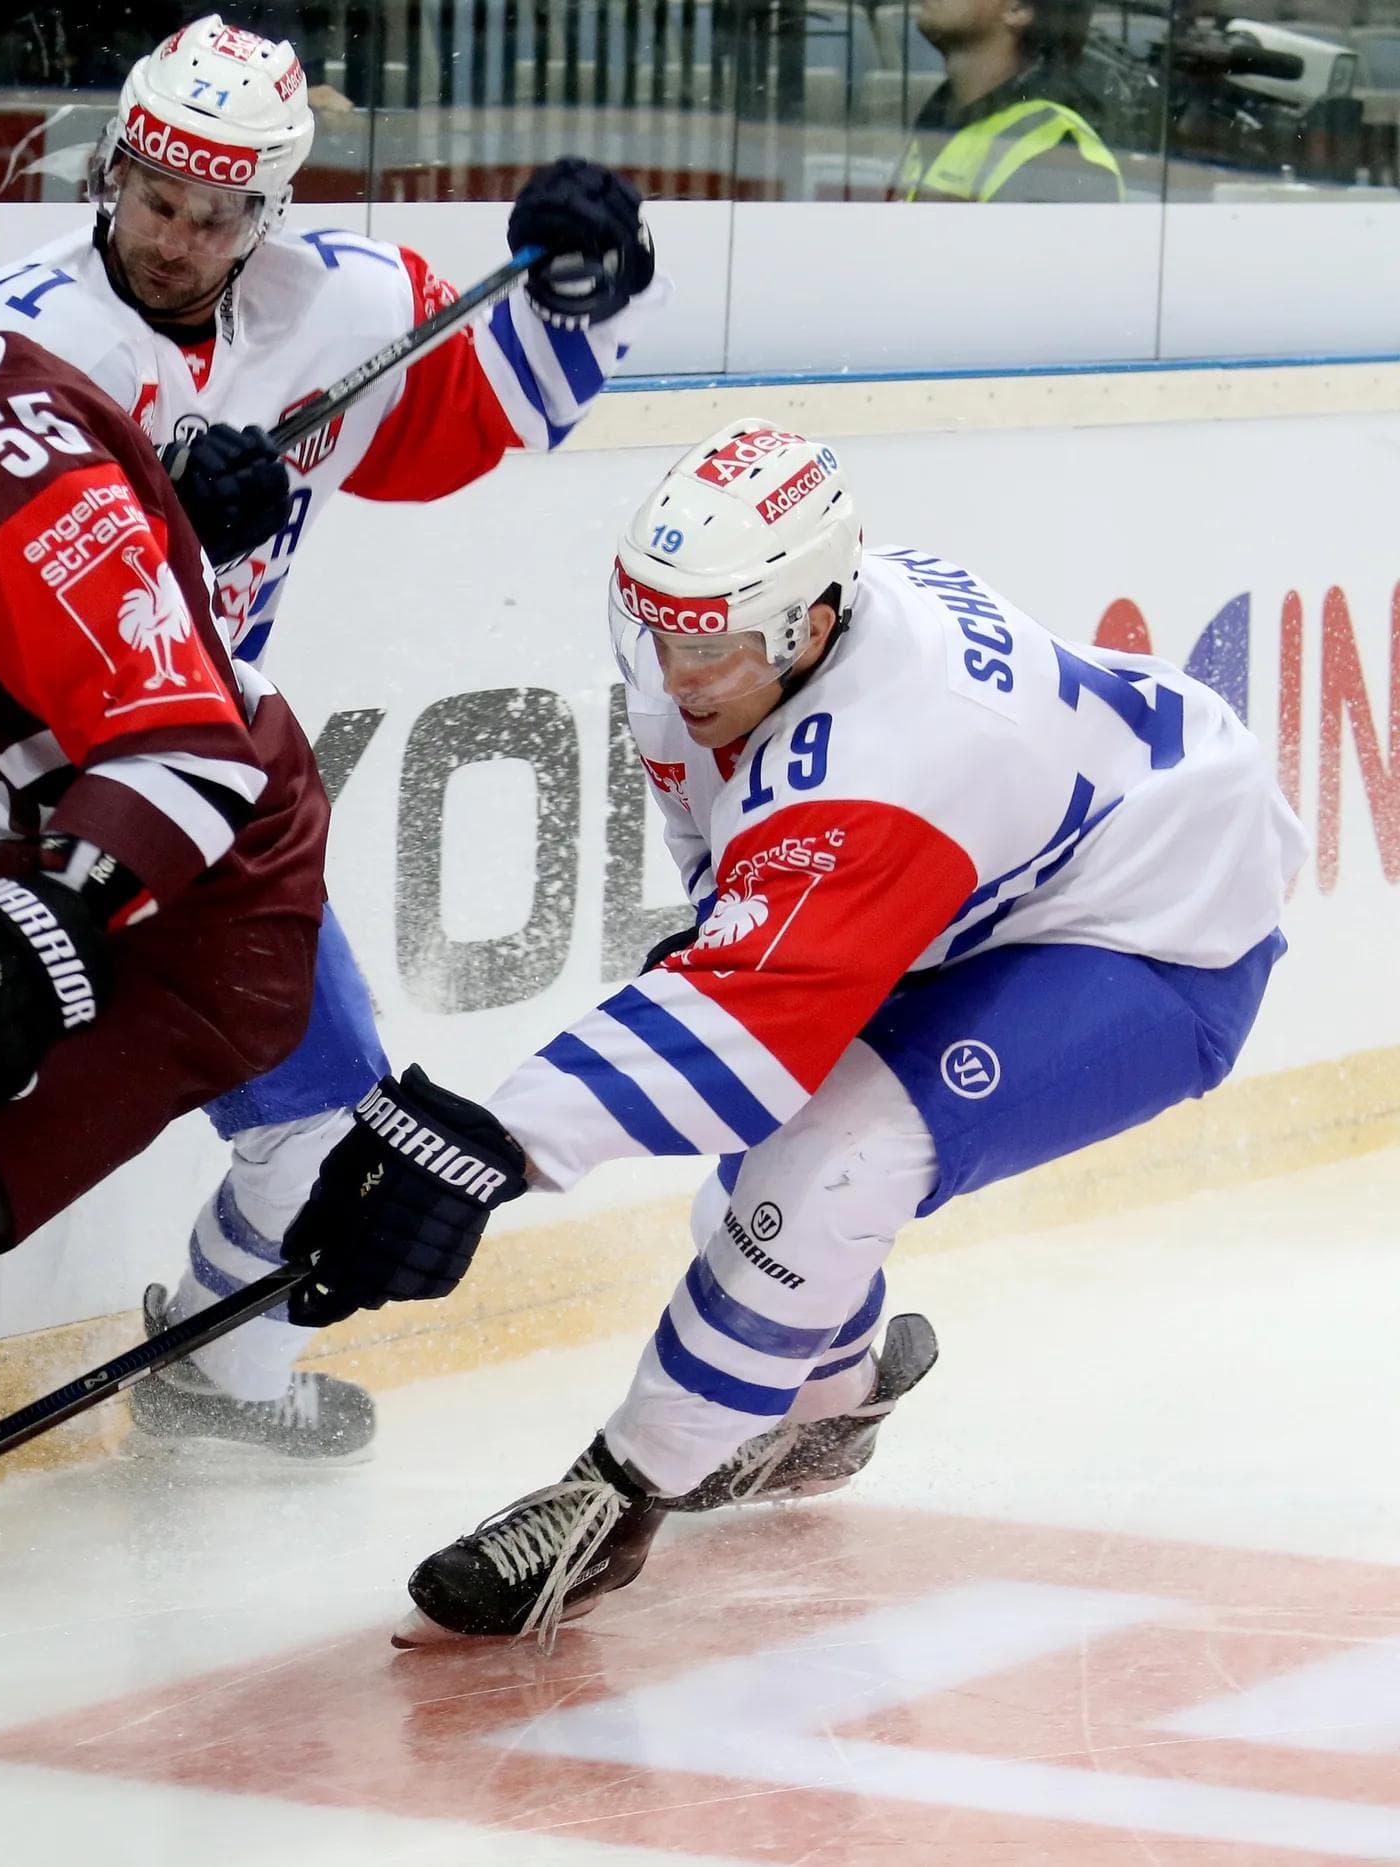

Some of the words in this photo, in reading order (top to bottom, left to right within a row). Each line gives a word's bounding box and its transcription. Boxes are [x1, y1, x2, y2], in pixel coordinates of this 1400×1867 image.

[190, 79, 231, 109] 71
[126, 113, 252, 183] Adecco
[816, 447, 838, 477] 19
[23, 483, 131, 564] engelber
[765, 466, 823, 522] Adecco
[651, 523, 685, 555] 19
[616, 567, 726, 634] decco
[742, 711, 833, 814] 19
